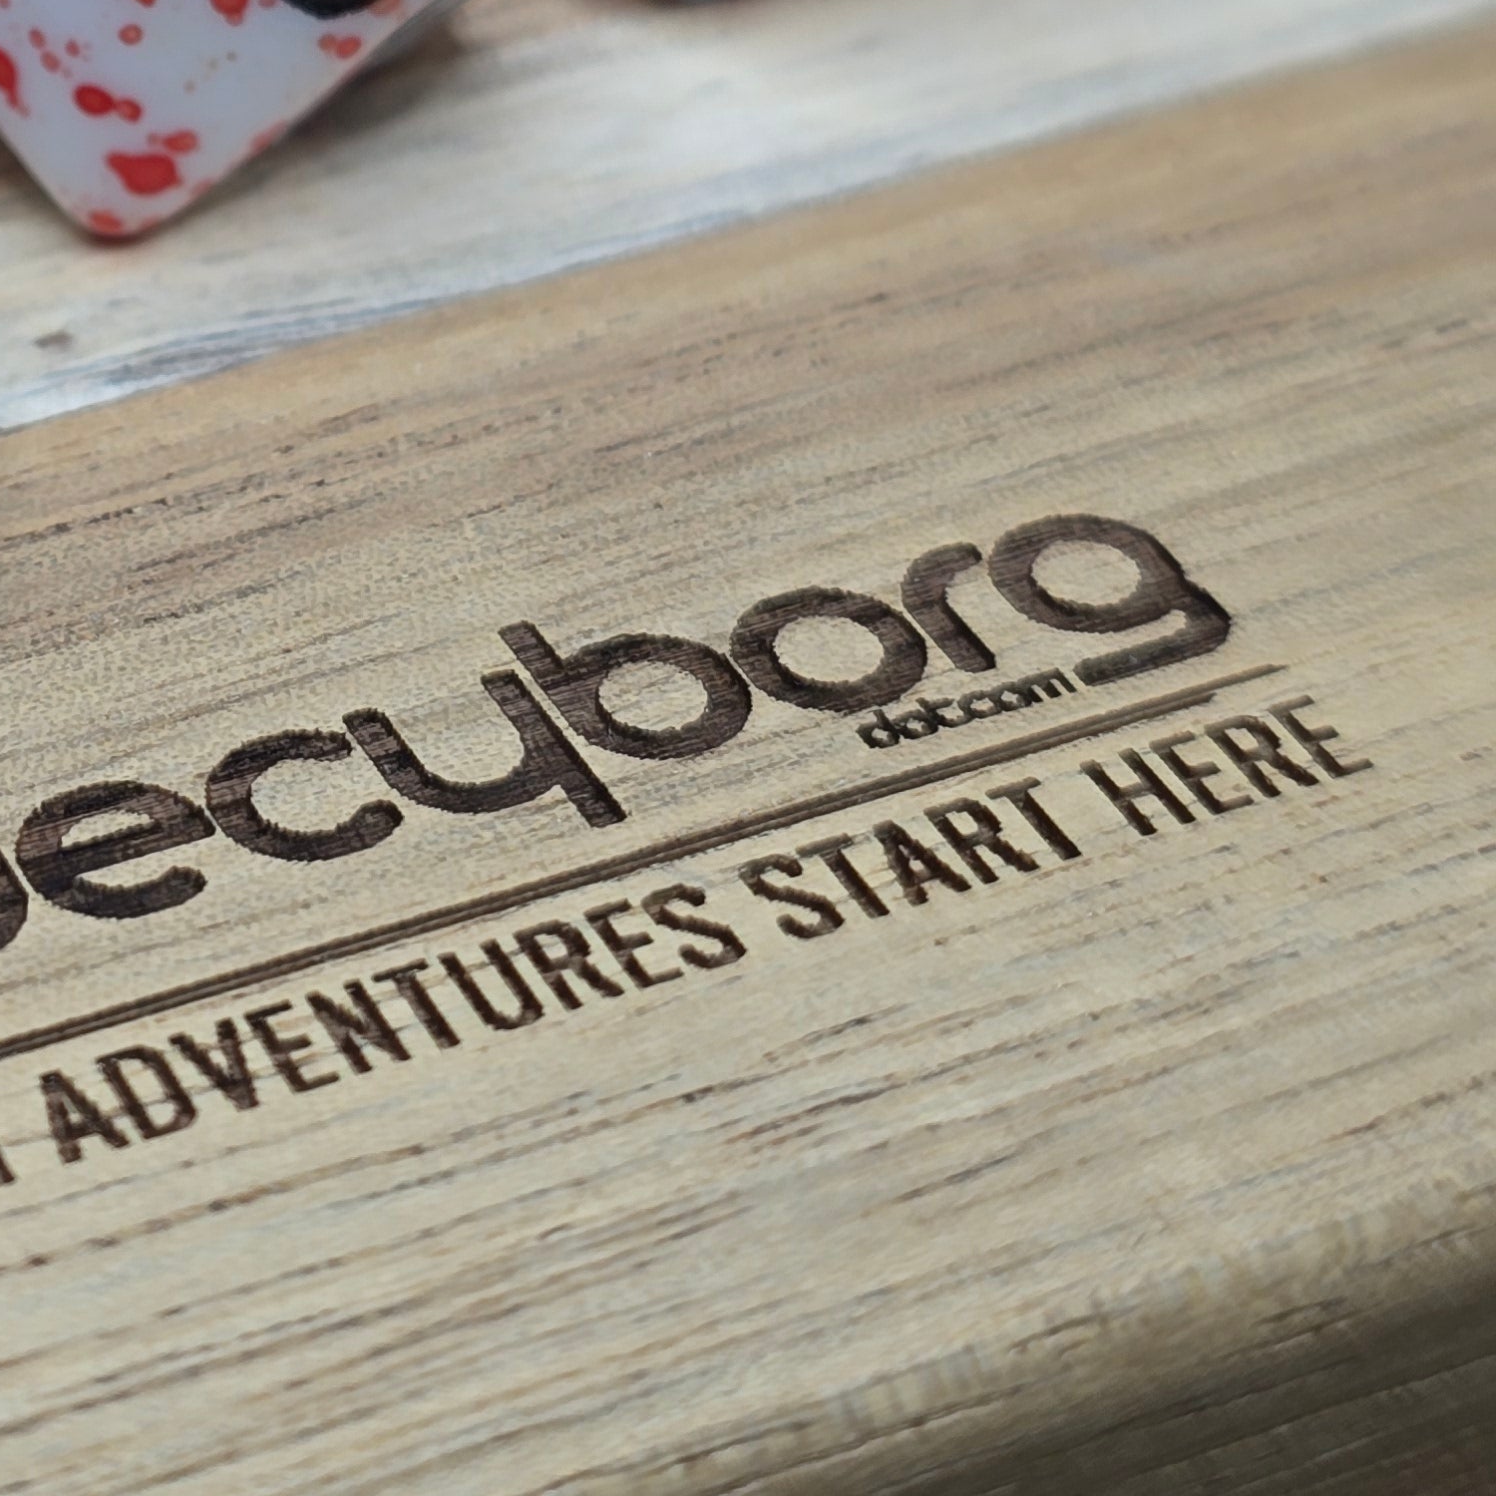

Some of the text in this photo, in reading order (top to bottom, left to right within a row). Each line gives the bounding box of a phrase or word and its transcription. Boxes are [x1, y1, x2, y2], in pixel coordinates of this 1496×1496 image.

[855, 667, 1079, 750] dotcom
[39, 882, 748, 1165] ADVENTURES
[738, 777, 1082, 940] START
[1079, 695, 1374, 837] HERE
